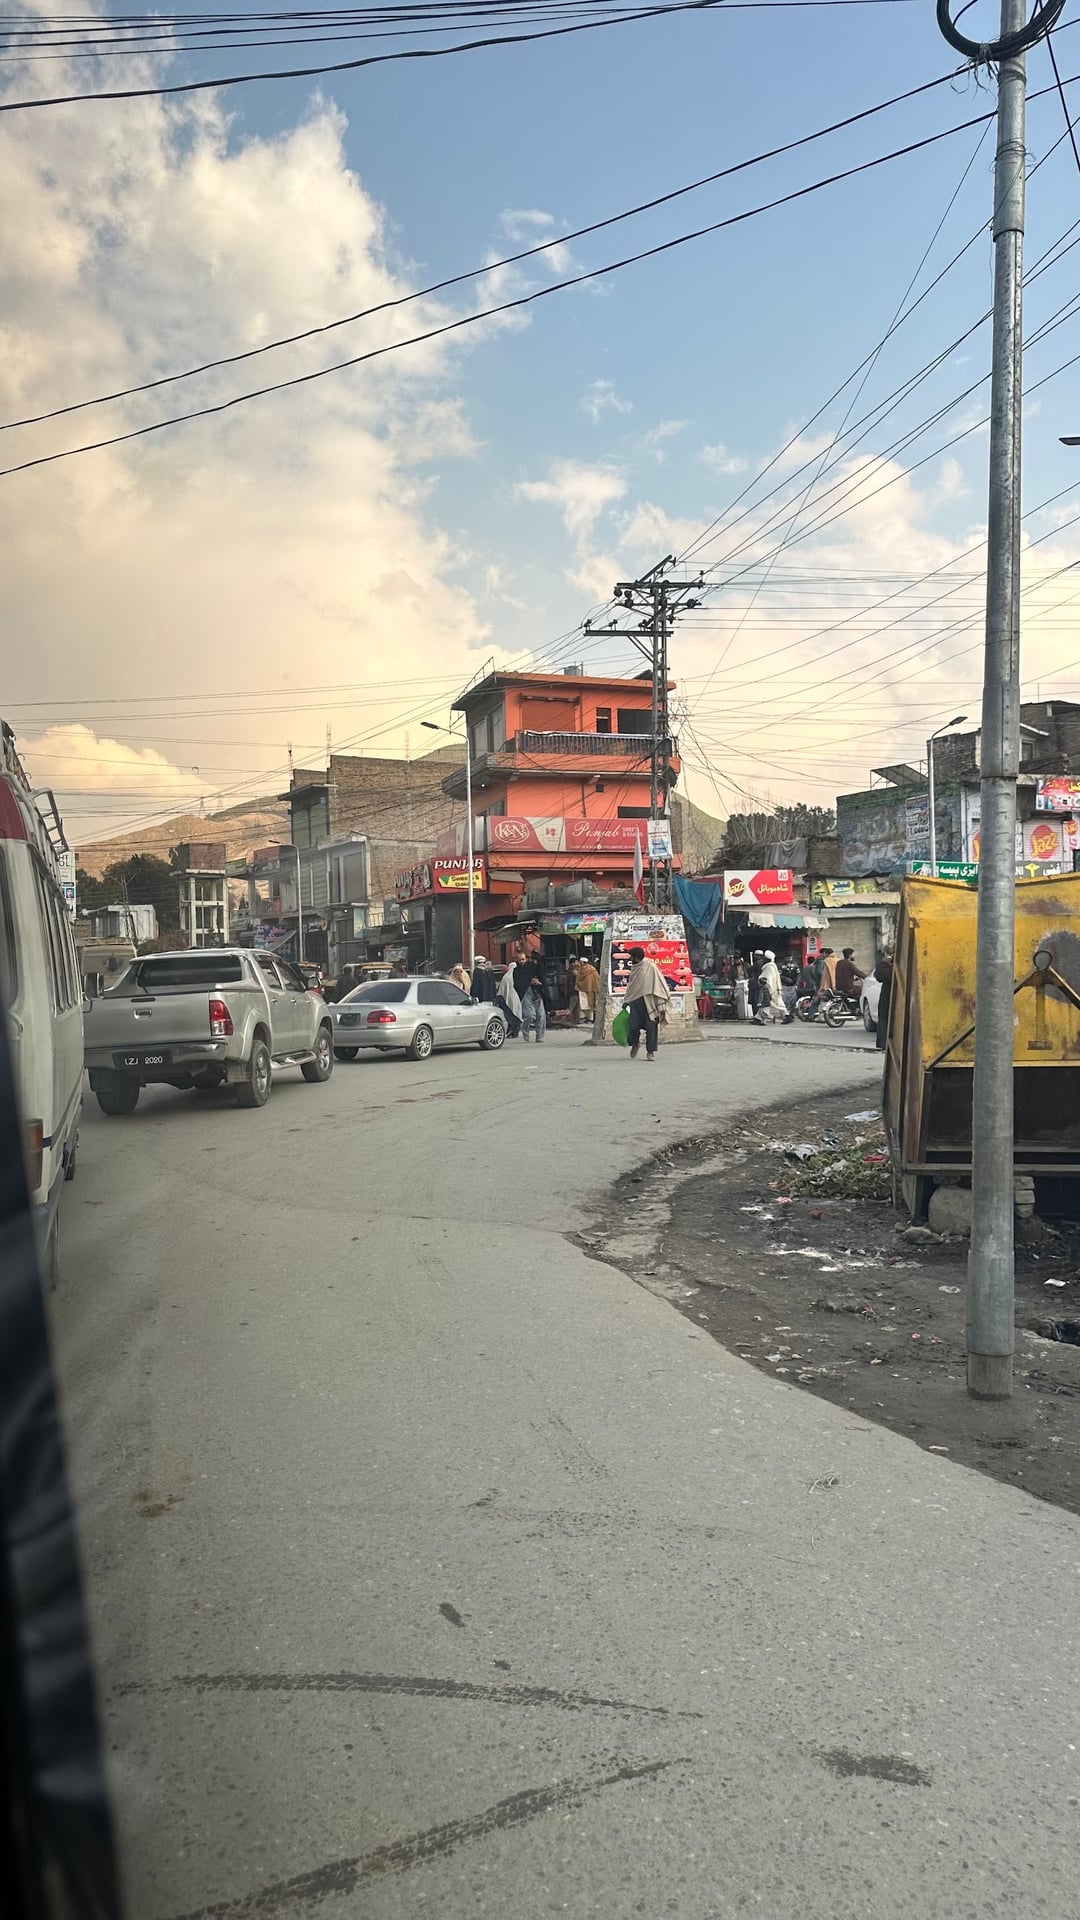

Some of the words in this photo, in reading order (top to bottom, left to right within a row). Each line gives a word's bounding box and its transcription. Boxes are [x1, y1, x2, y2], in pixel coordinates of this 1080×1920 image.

[572, 821, 621, 842] Punjab
[1032, 832, 1059, 857] Jazz
[727, 880, 745, 896] Jazz
[144, 1055, 163, 1065] 2020
